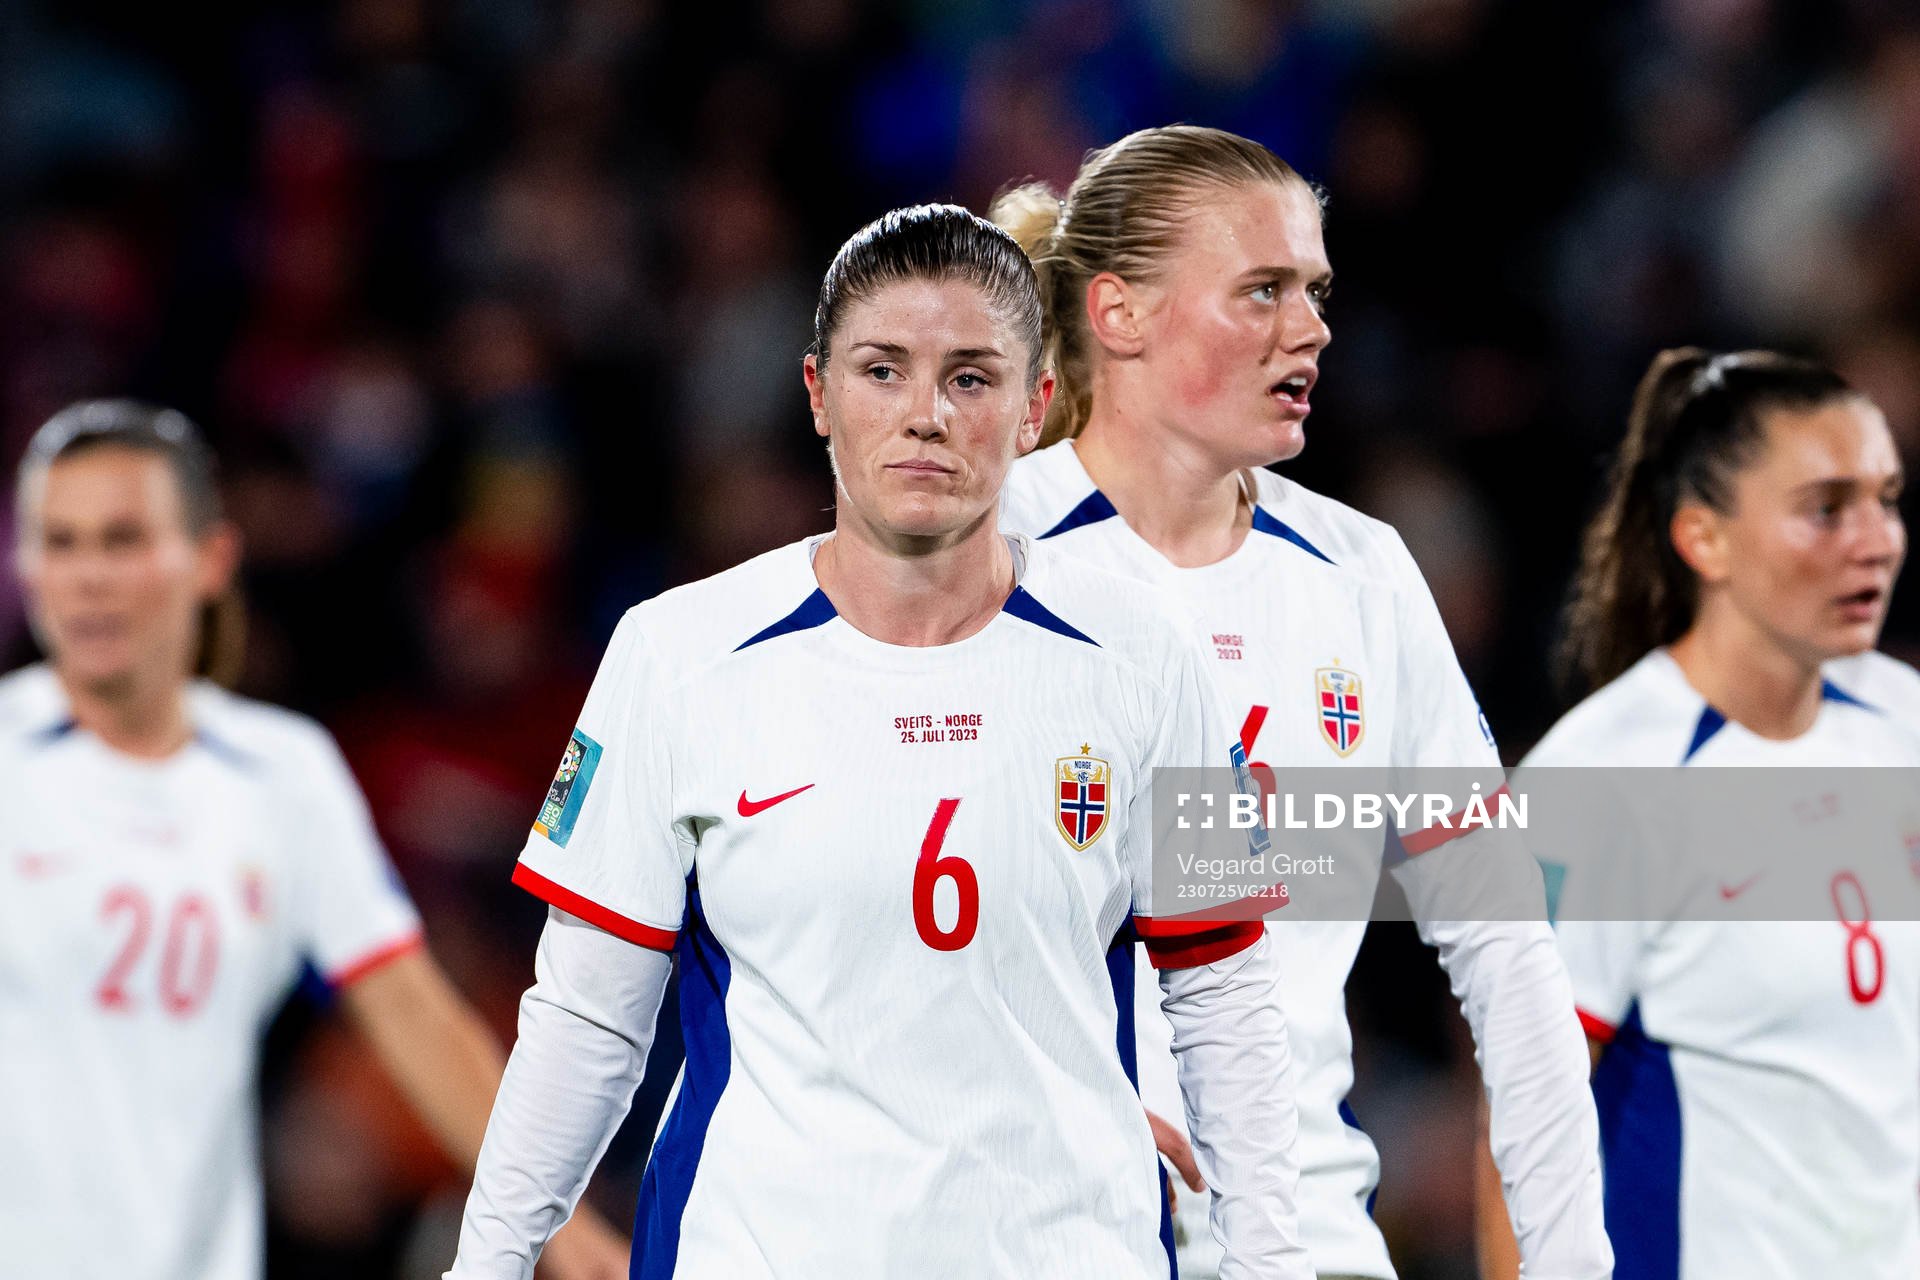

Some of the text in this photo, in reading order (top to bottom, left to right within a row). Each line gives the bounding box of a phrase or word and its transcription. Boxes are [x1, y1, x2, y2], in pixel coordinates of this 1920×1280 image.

[894, 715, 933, 729] SVEITS
[945, 714, 983, 727] NORGE
[901, 728, 978, 743] 25. JULI 2023
[1074, 760, 1092, 770] NORGE
[911, 797, 980, 952] 6
[94, 883, 222, 1018] 20
[1830, 868, 1886, 1006] 8
